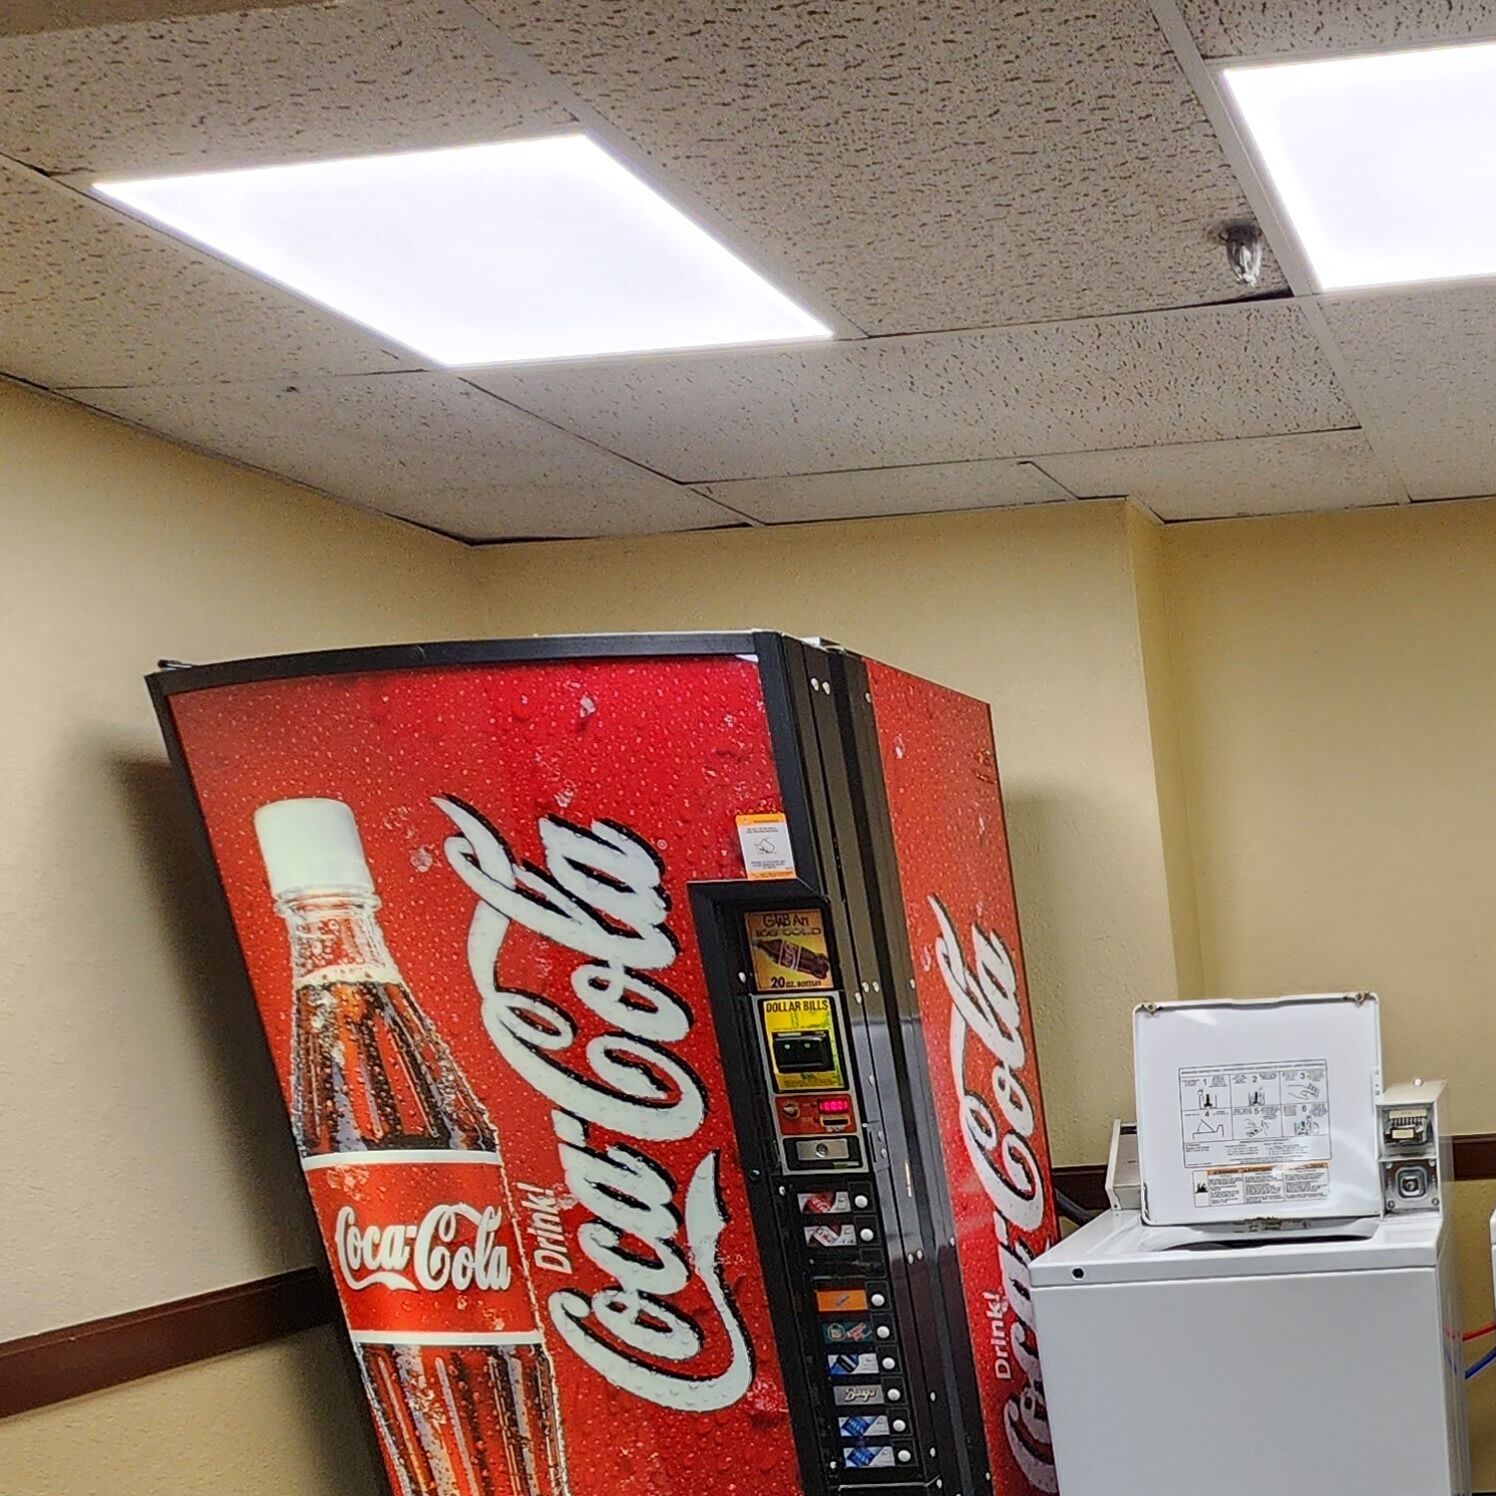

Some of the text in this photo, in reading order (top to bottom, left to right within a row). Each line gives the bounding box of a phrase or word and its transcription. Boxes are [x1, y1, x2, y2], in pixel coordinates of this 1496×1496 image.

[766, 1000, 829, 1013] DOLLAR BILLS
[770, 976, 786, 988] 20
[430, 794, 757, 1412] Coca-Cola
[335, 1202, 512, 1291] Coca-Cola
[517, 1181, 572, 1274] Drink!
[983, 1290, 1011, 1379] Drink!
